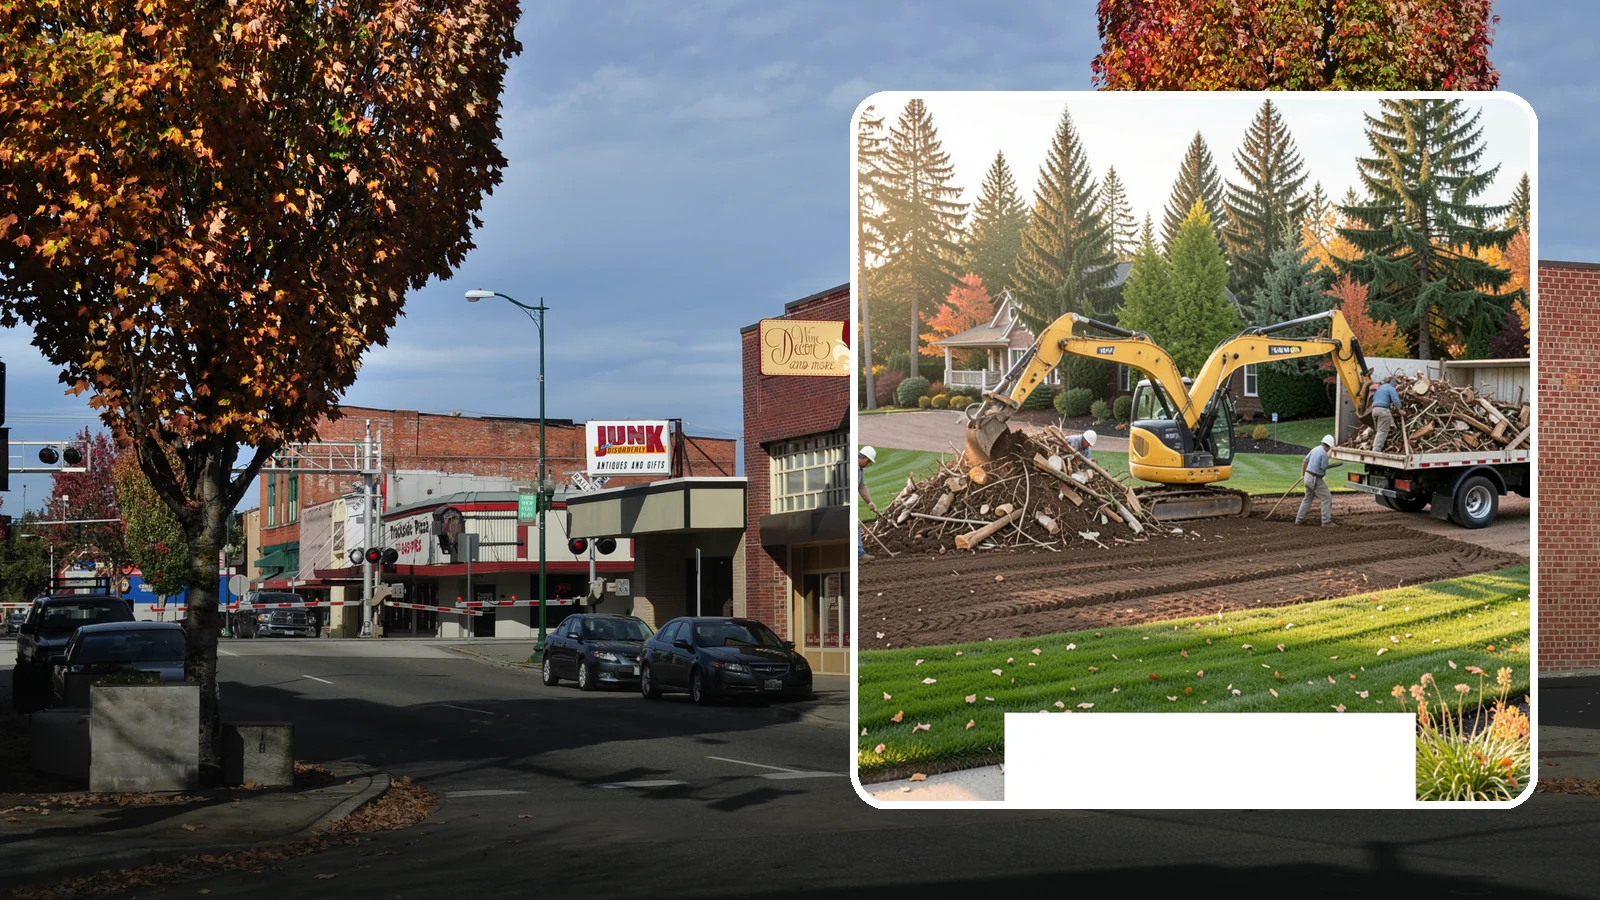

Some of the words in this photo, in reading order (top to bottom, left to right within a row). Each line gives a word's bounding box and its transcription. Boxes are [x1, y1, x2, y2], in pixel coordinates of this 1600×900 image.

[595, 425, 665, 457] JUNK
[607, 446, 646, 454] DISORDERLY
[596, 461, 628, 470] ANTIQUES
[631, 461, 643, 470] AND
[647, 460, 665, 469] GIFTS
[573, 473, 589, 492] RAIL
[352, 499, 365, 511] CRO
[414, 519, 429, 535] Pizza
